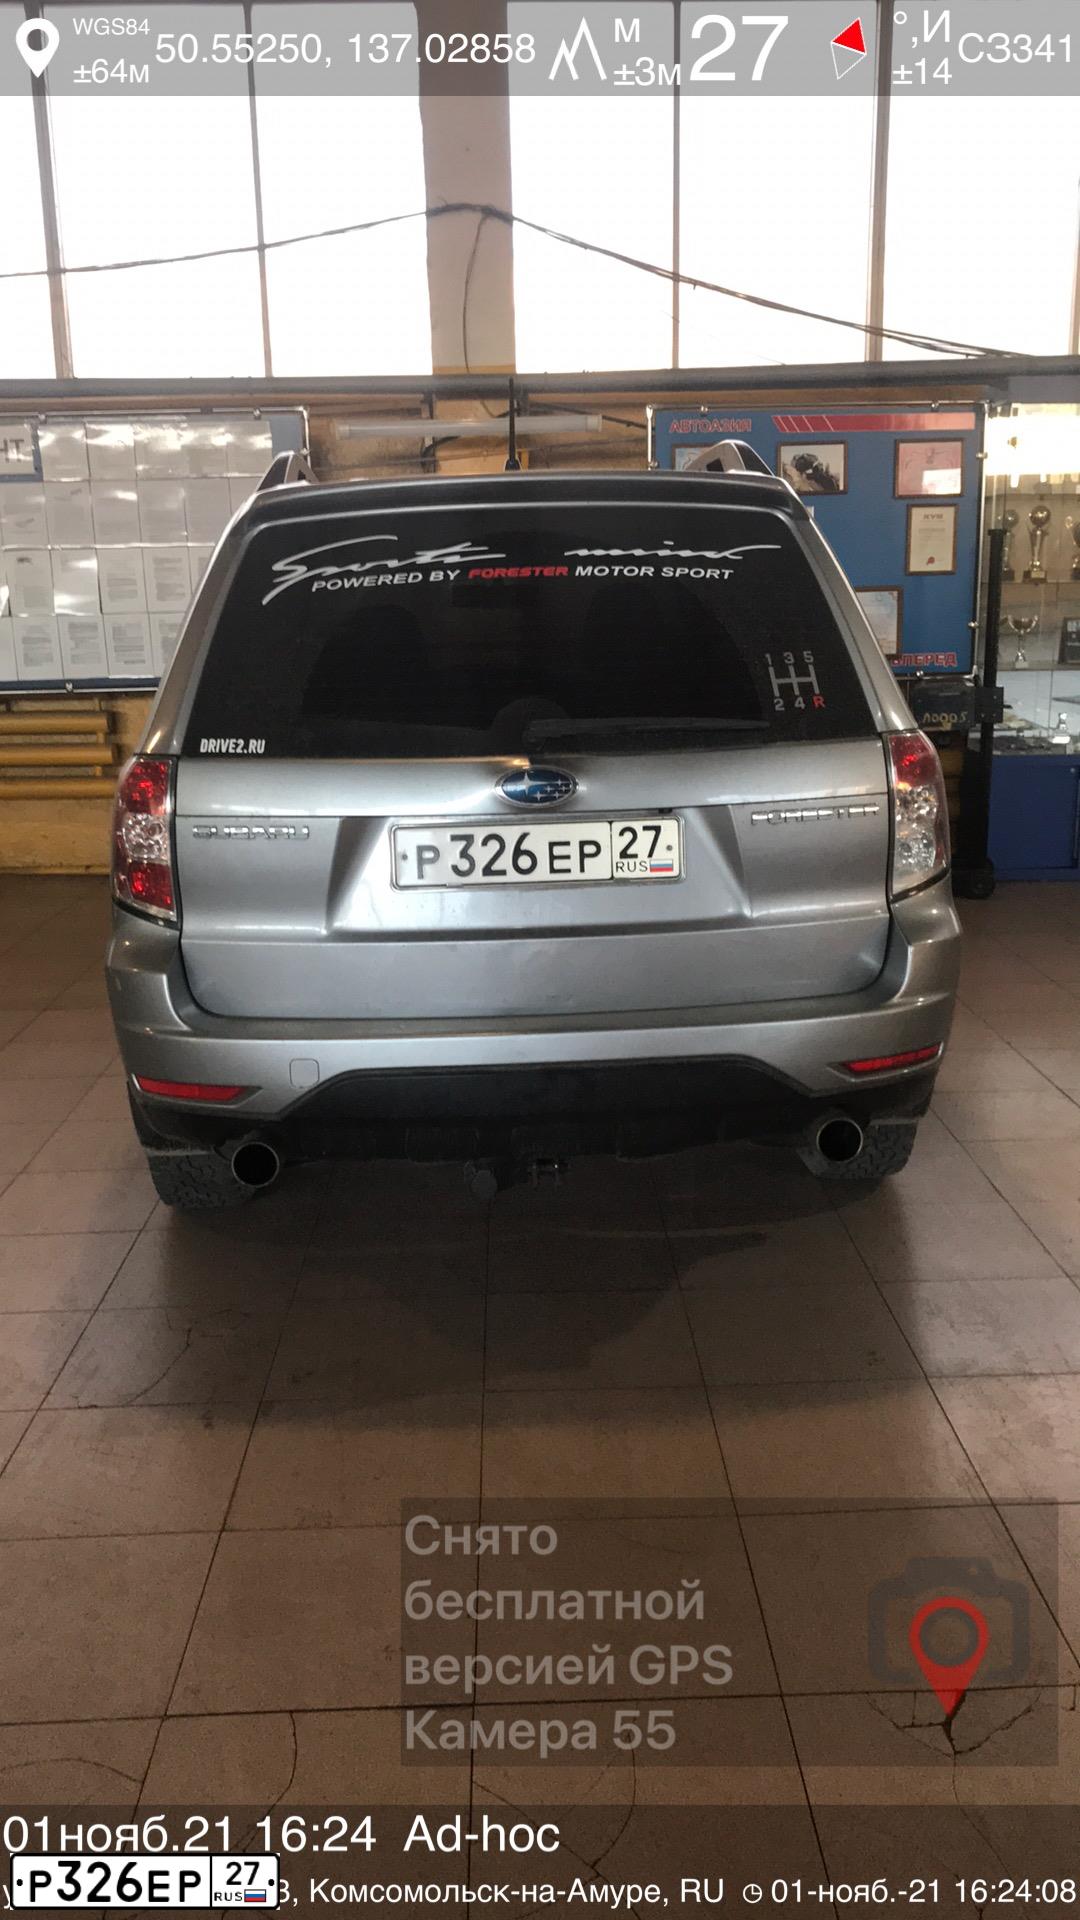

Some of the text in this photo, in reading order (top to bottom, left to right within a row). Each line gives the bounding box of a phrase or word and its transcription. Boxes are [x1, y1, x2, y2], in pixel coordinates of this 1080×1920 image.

[312, 565, 734, 592] POWERED BY FORESTER MOTOR SPORT
[765, 650, 815, 665] 1 3 5
[774, 695, 826, 711] 2 4 R
[200, 738, 266, 754] DRIVE2.RU
[618, 825, 662, 859] 27
[615, 860, 649, 873] RUS
